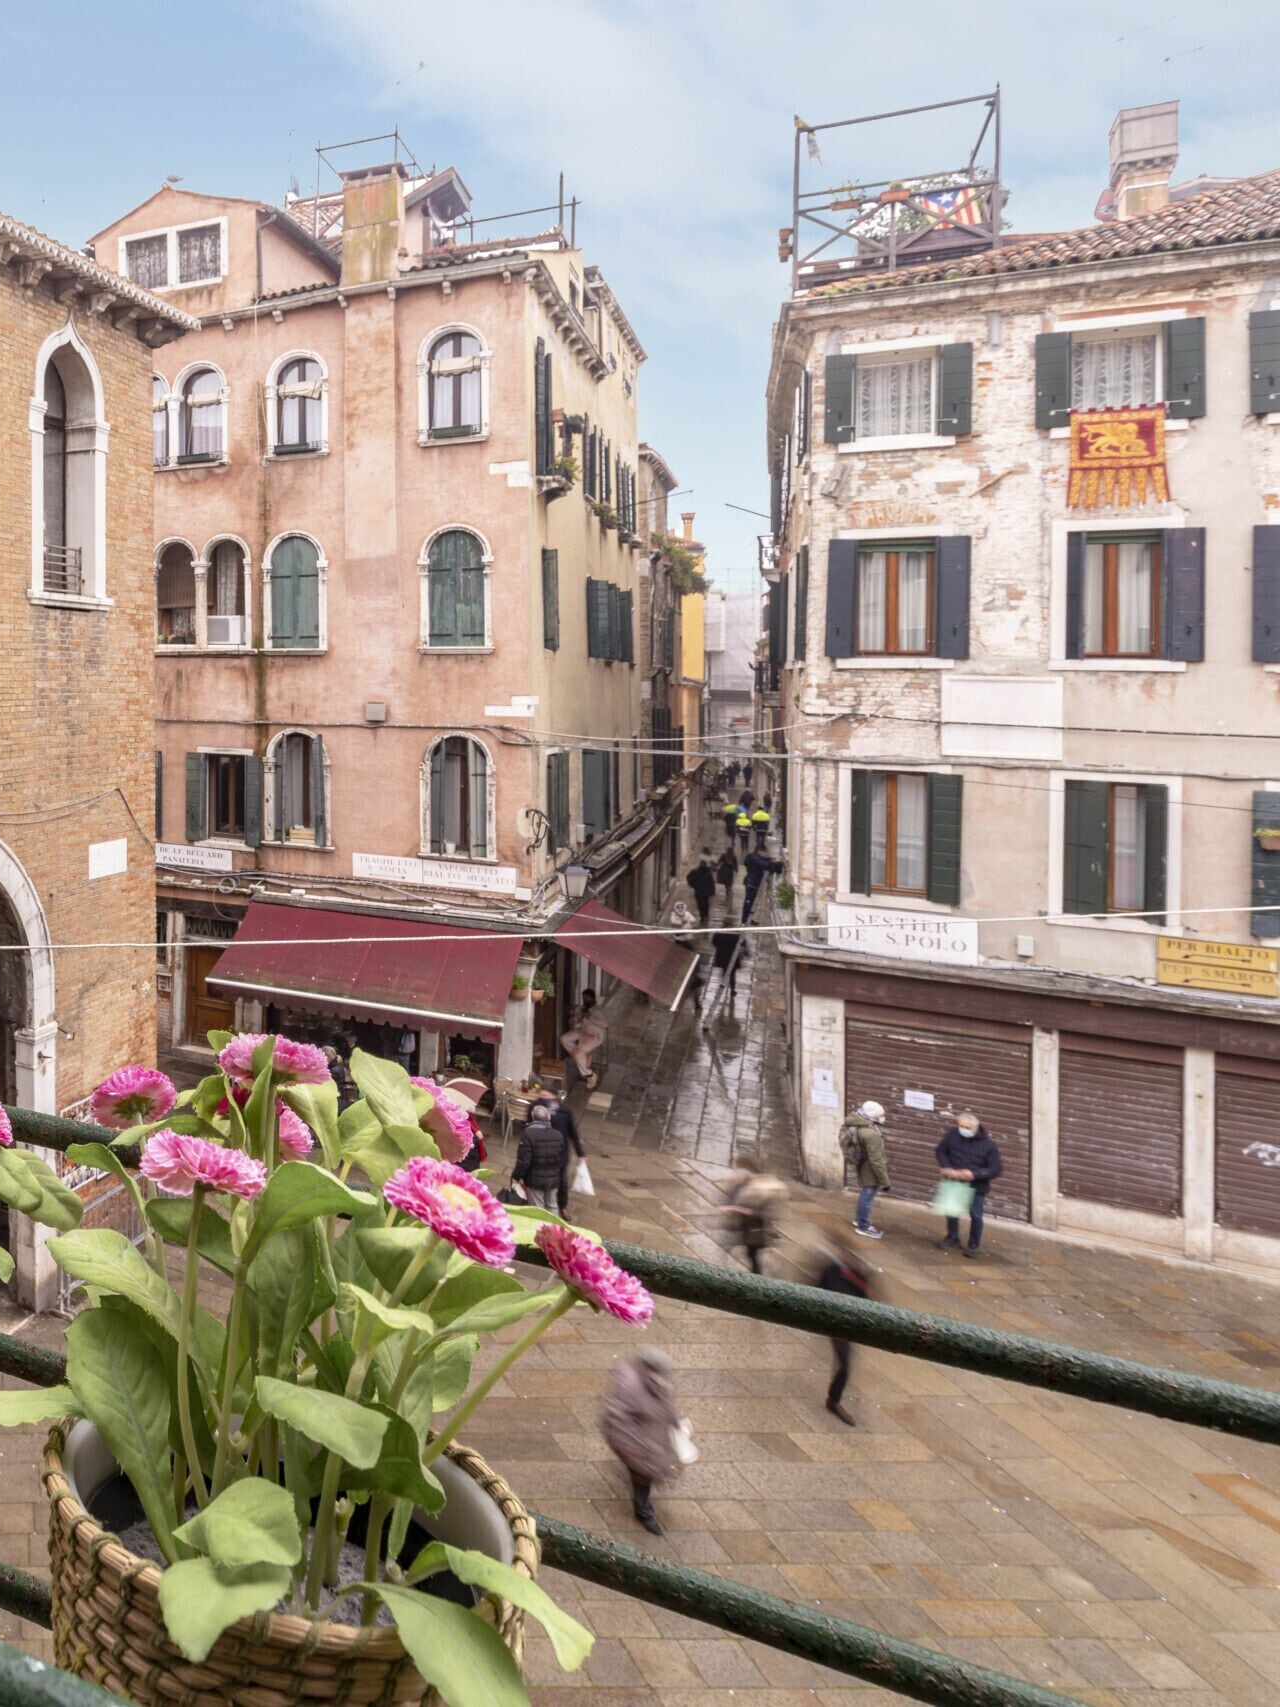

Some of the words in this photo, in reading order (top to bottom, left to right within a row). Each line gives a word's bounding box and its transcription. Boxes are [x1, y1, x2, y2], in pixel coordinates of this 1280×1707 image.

[855, 913, 949, 934] SESTIER
[839, 926, 867, 942] DE
[1166, 940, 1197, 952] PER
[1206, 944, 1270, 960] RIALTO
[1162, 963, 1193, 975] PER
